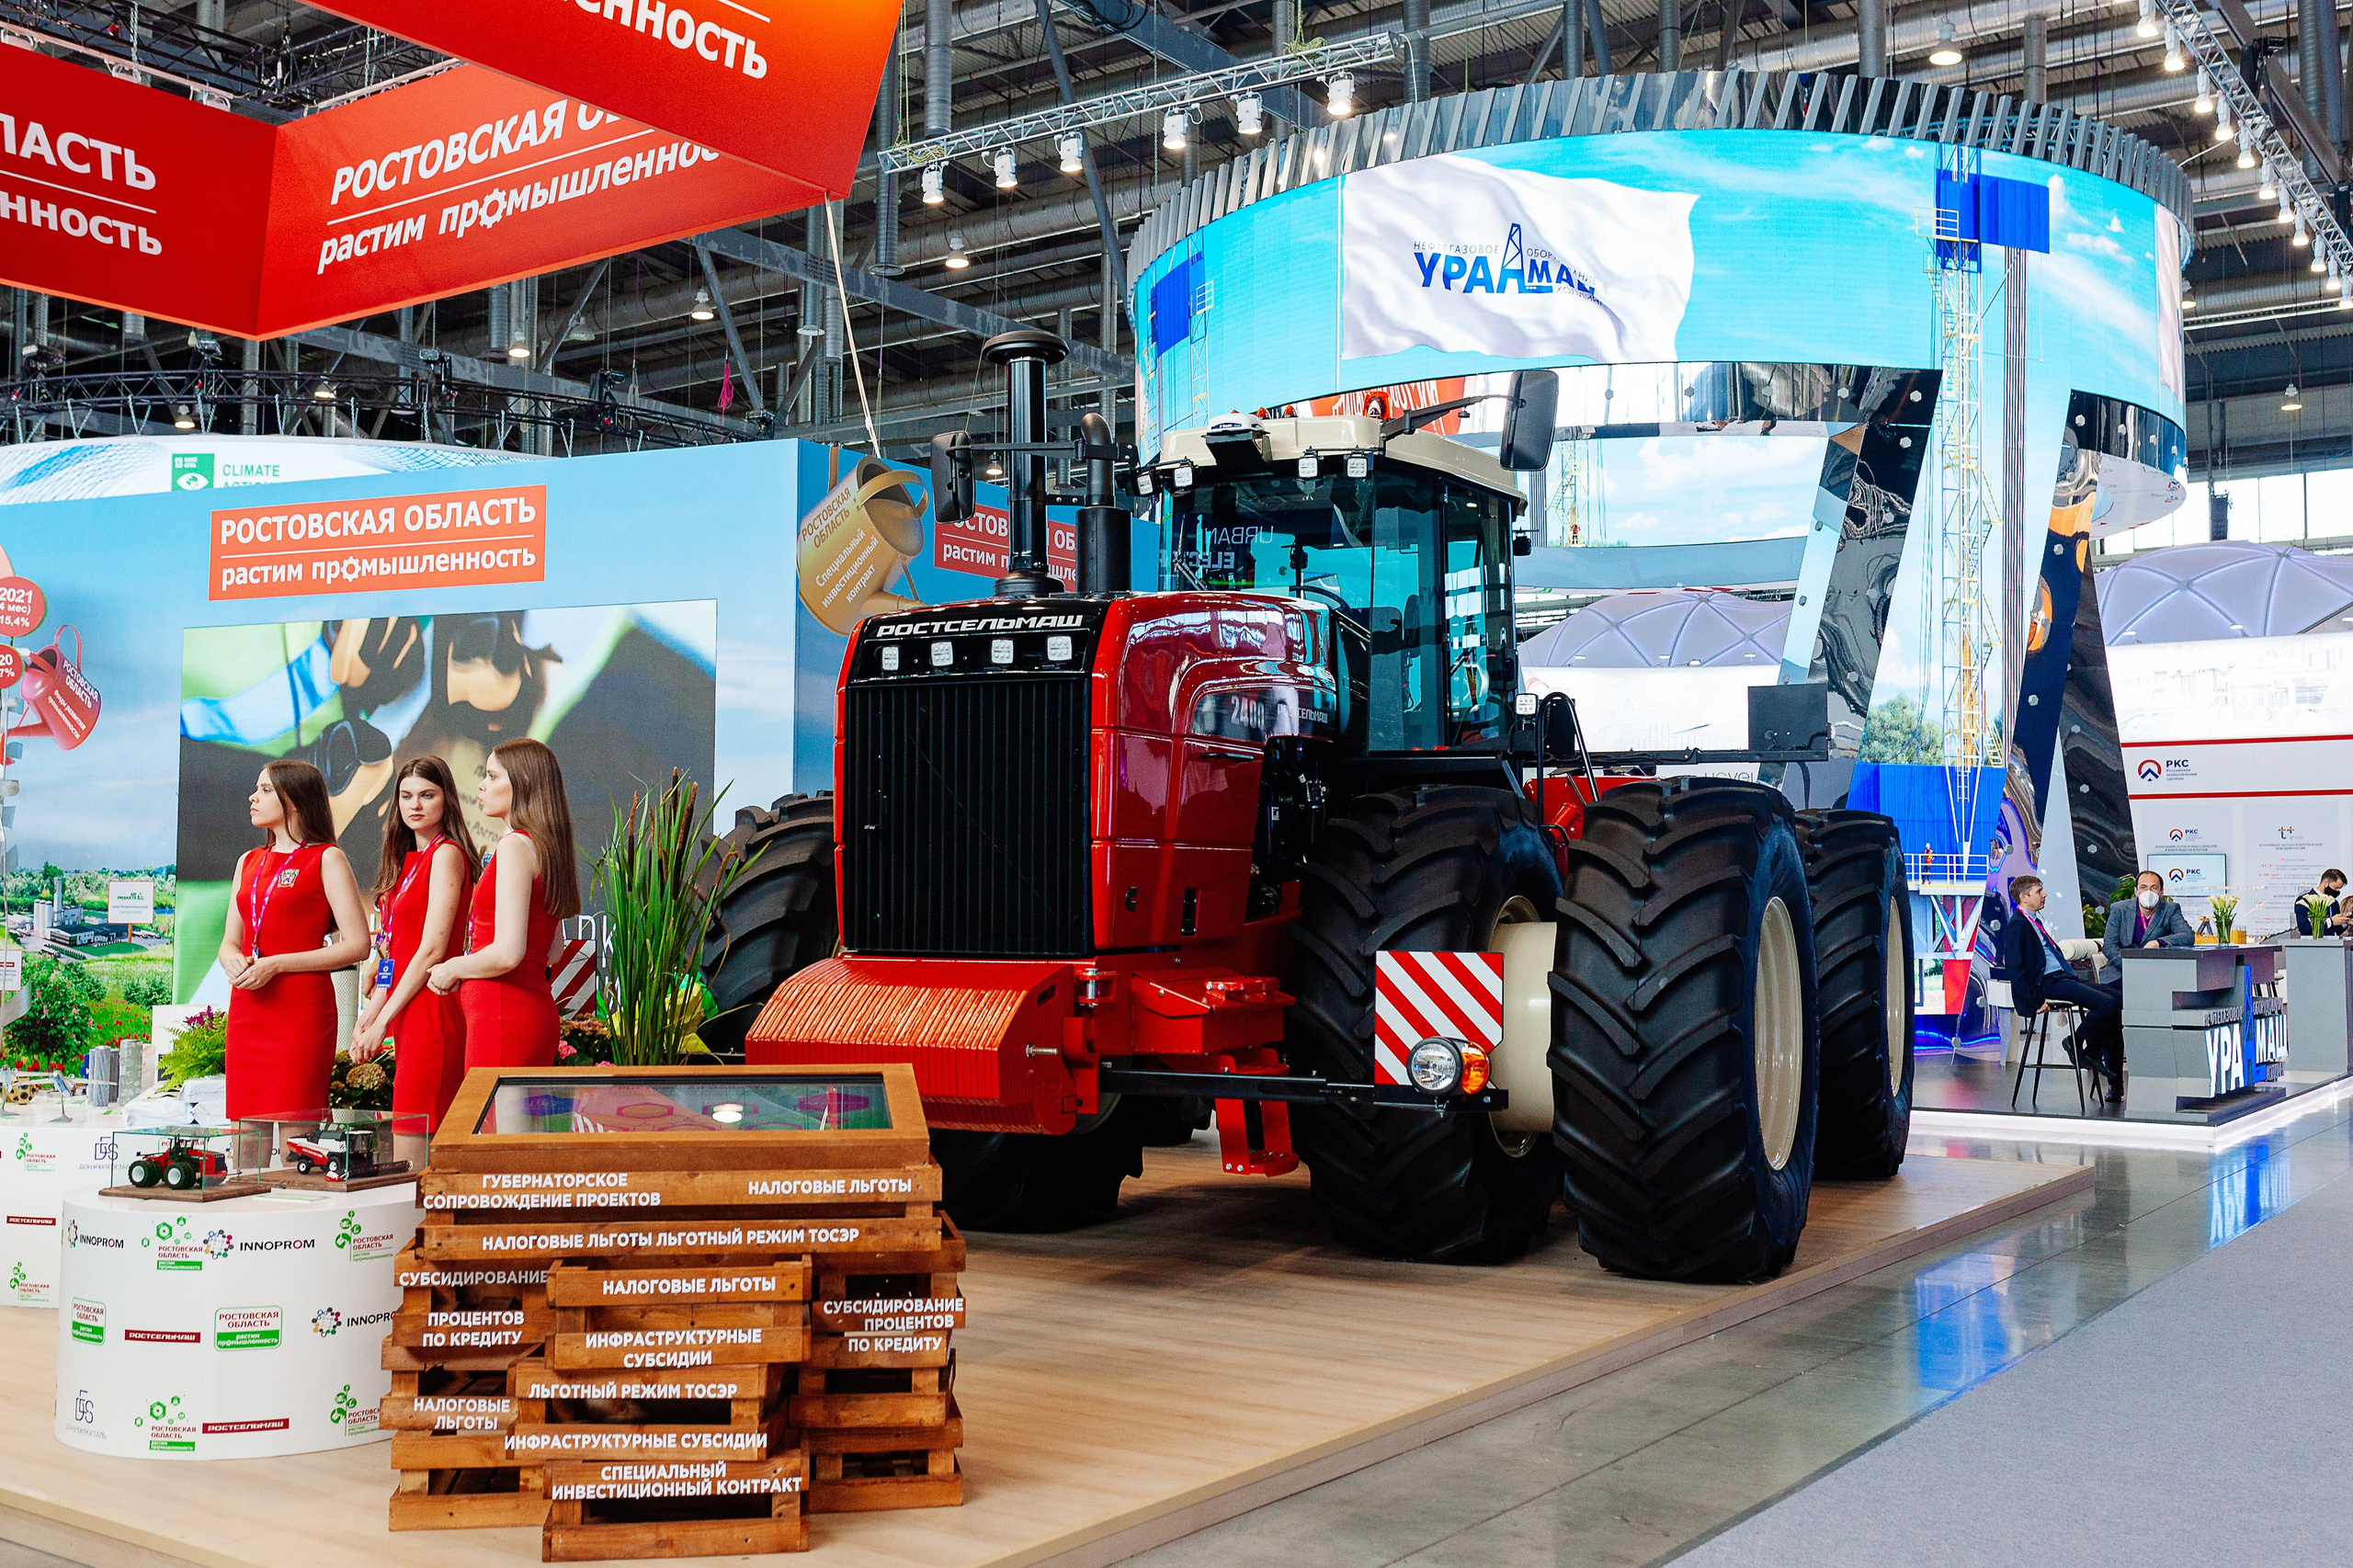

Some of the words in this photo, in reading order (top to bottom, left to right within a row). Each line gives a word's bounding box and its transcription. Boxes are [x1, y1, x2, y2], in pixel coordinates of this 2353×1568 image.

[330, 99, 568, 205] РОСТОВСКАЯ
[317, 215, 426, 274] растим
[222, 464, 280, 477] CLIMATE
[221, 507, 395, 545] РОСТОВСКАЯ
[404, 497, 536, 531] ОБЛАСТЬ
[801, 487, 851, 541] РОСТОВСКАЯ
[813, 508, 850, 549] ОБЛАСТЬ
[815, 528, 866, 587] Специальный
[943, 543, 995, 566] растим
[222, 562, 302, 591] растим
[312, 548, 536, 585] промышленность
[822, 535, 880, 608] инвестиционный
[846, 564, 876, 603] контракт
[877, 615, 1083, 637] РОСТСЕЛЬМАШ
[63, 659, 99, 703] РОСТОВСКАЯ
[65, 676, 93, 710] ОБЛАСТЬ
[1231, 695, 1265, 731] 2400
[2165, 759, 2188, 767] РКС
[483, 1173, 628, 1189] ГУБЕРНАТОРСКОЕ
[748, 1179, 846, 1195] НАЛОГОВЫЕ
[848, 1178, 912, 1194] ЛЬГОТЫ
[423, 1194, 572, 1210] СОПРОВОЖДЕНИЕ
[576, 1192, 661, 1208] ПРОЕКТОВ
[79, 1233, 124, 1249] INNOPROM
[240, 1239, 315, 1251] INNOPROM
[352, 1243, 382, 1251] ОБЛАСТЬ
[353, 1233, 394, 1244] РОСТОВСКАЯ
[483, 1234, 584, 1251] НАЛОГОВЫЕ
[586, 1233, 652, 1248] ЛЬГОТЫ
[655, 1228, 743, 1246] ЛЬГОТНЫЙ
[746, 1229, 805, 1244] РЕЖИМ
[809, 1228, 859, 1243] ТОСЭР
[399, 1270, 548, 1287] СУБСИДИРОВАНИЕ
[602, 1278, 706, 1295] НАЛОГОВЫЕ
[709, 1277, 776, 1292] ЛЬГОТЫ
[73, 1302, 105, 1315] РОСТОВСКАЯ
[823, 1298, 964, 1315] СУБСИДИРОВАНИЕ
[76, 1312, 98, 1322] ОБЛАСТЬ
[219, 1312, 279, 1320] РОСТОВСКАЯ
[227, 1320, 270, 1328] ОБЛАСТЬ
[427, 1311, 525, 1327] ПРОЦЕНТОВ
[864, 1314, 954, 1331] ПРОЦЕНТОВ
[129, 1333, 196, 1341] РОСТСЕЛЬМАШ
[422, 1333, 446, 1347] ПО
[449, 1331, 522, 1347] КРЕДИТУ
[585, 1328, 762, 1348] ИНФРАСТРУКТУРНЫЕ
[848, 1338, 870, 1352] ПО
[874, 1336, 942, 1353] КРЕДИТУ
[623, 1350, 712, 1369] СУБСИДИИ
[529, 1381, 617, 1399] ЛЬГОТНЫЙ
[621, 1384, 681, 1399] РЕЖИМ
[685, 1383, 738, 1399] ТОСЭР
[414, 1398, 510, 1413] НАЛОГОВЫЕ
[207, 1421, 284, 1432] РОСТСЕЛЬМАШ
[347, 1415, 378, 1425] ОБЛАСТЬ
[435, 1415, 497, 1430] ЛЬГОТЫ
[505, 1434, 676, 1450] ИНФРАСТРУКТУРНЫЕ
[680, 1433, 767, 1449] СУБСИДИИ
[601, 1460, 726, 1481] СПЕЦИАЛЬНЫЙ
[551, 1478, 712, 1500] ИНВЕСТИЦИОННЫЙ
[716, 1477, 802, 1494] КОНТРАКТ
